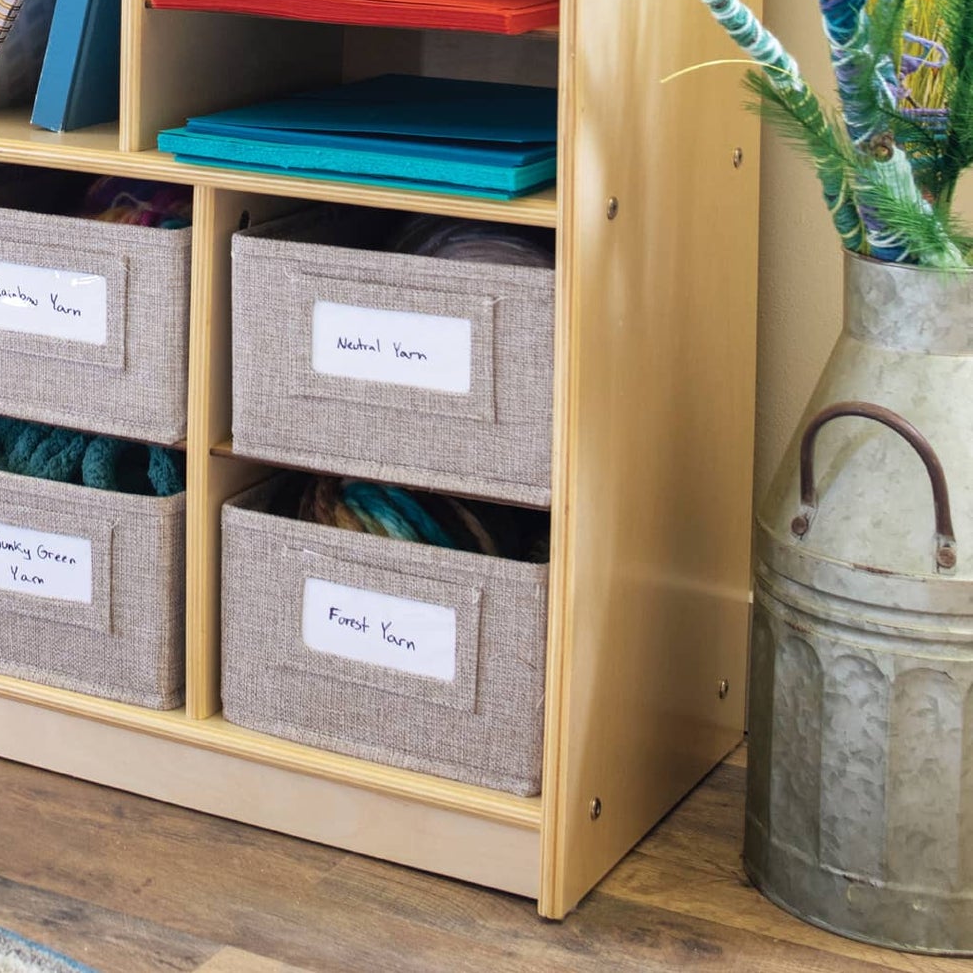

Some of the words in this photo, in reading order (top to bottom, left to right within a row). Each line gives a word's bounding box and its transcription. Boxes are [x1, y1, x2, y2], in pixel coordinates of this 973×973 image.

[49, 292, 82, 317] Yarn
[336, 336, 381, 353] Neutral
[392, 341, 428, 361] Yarn
[36, 543, 77, 565] Green
[10, 564, 45, 585] Yarn
[328, 606, 371, 633] Forest
[380, 620, 417, 651] Yarn
